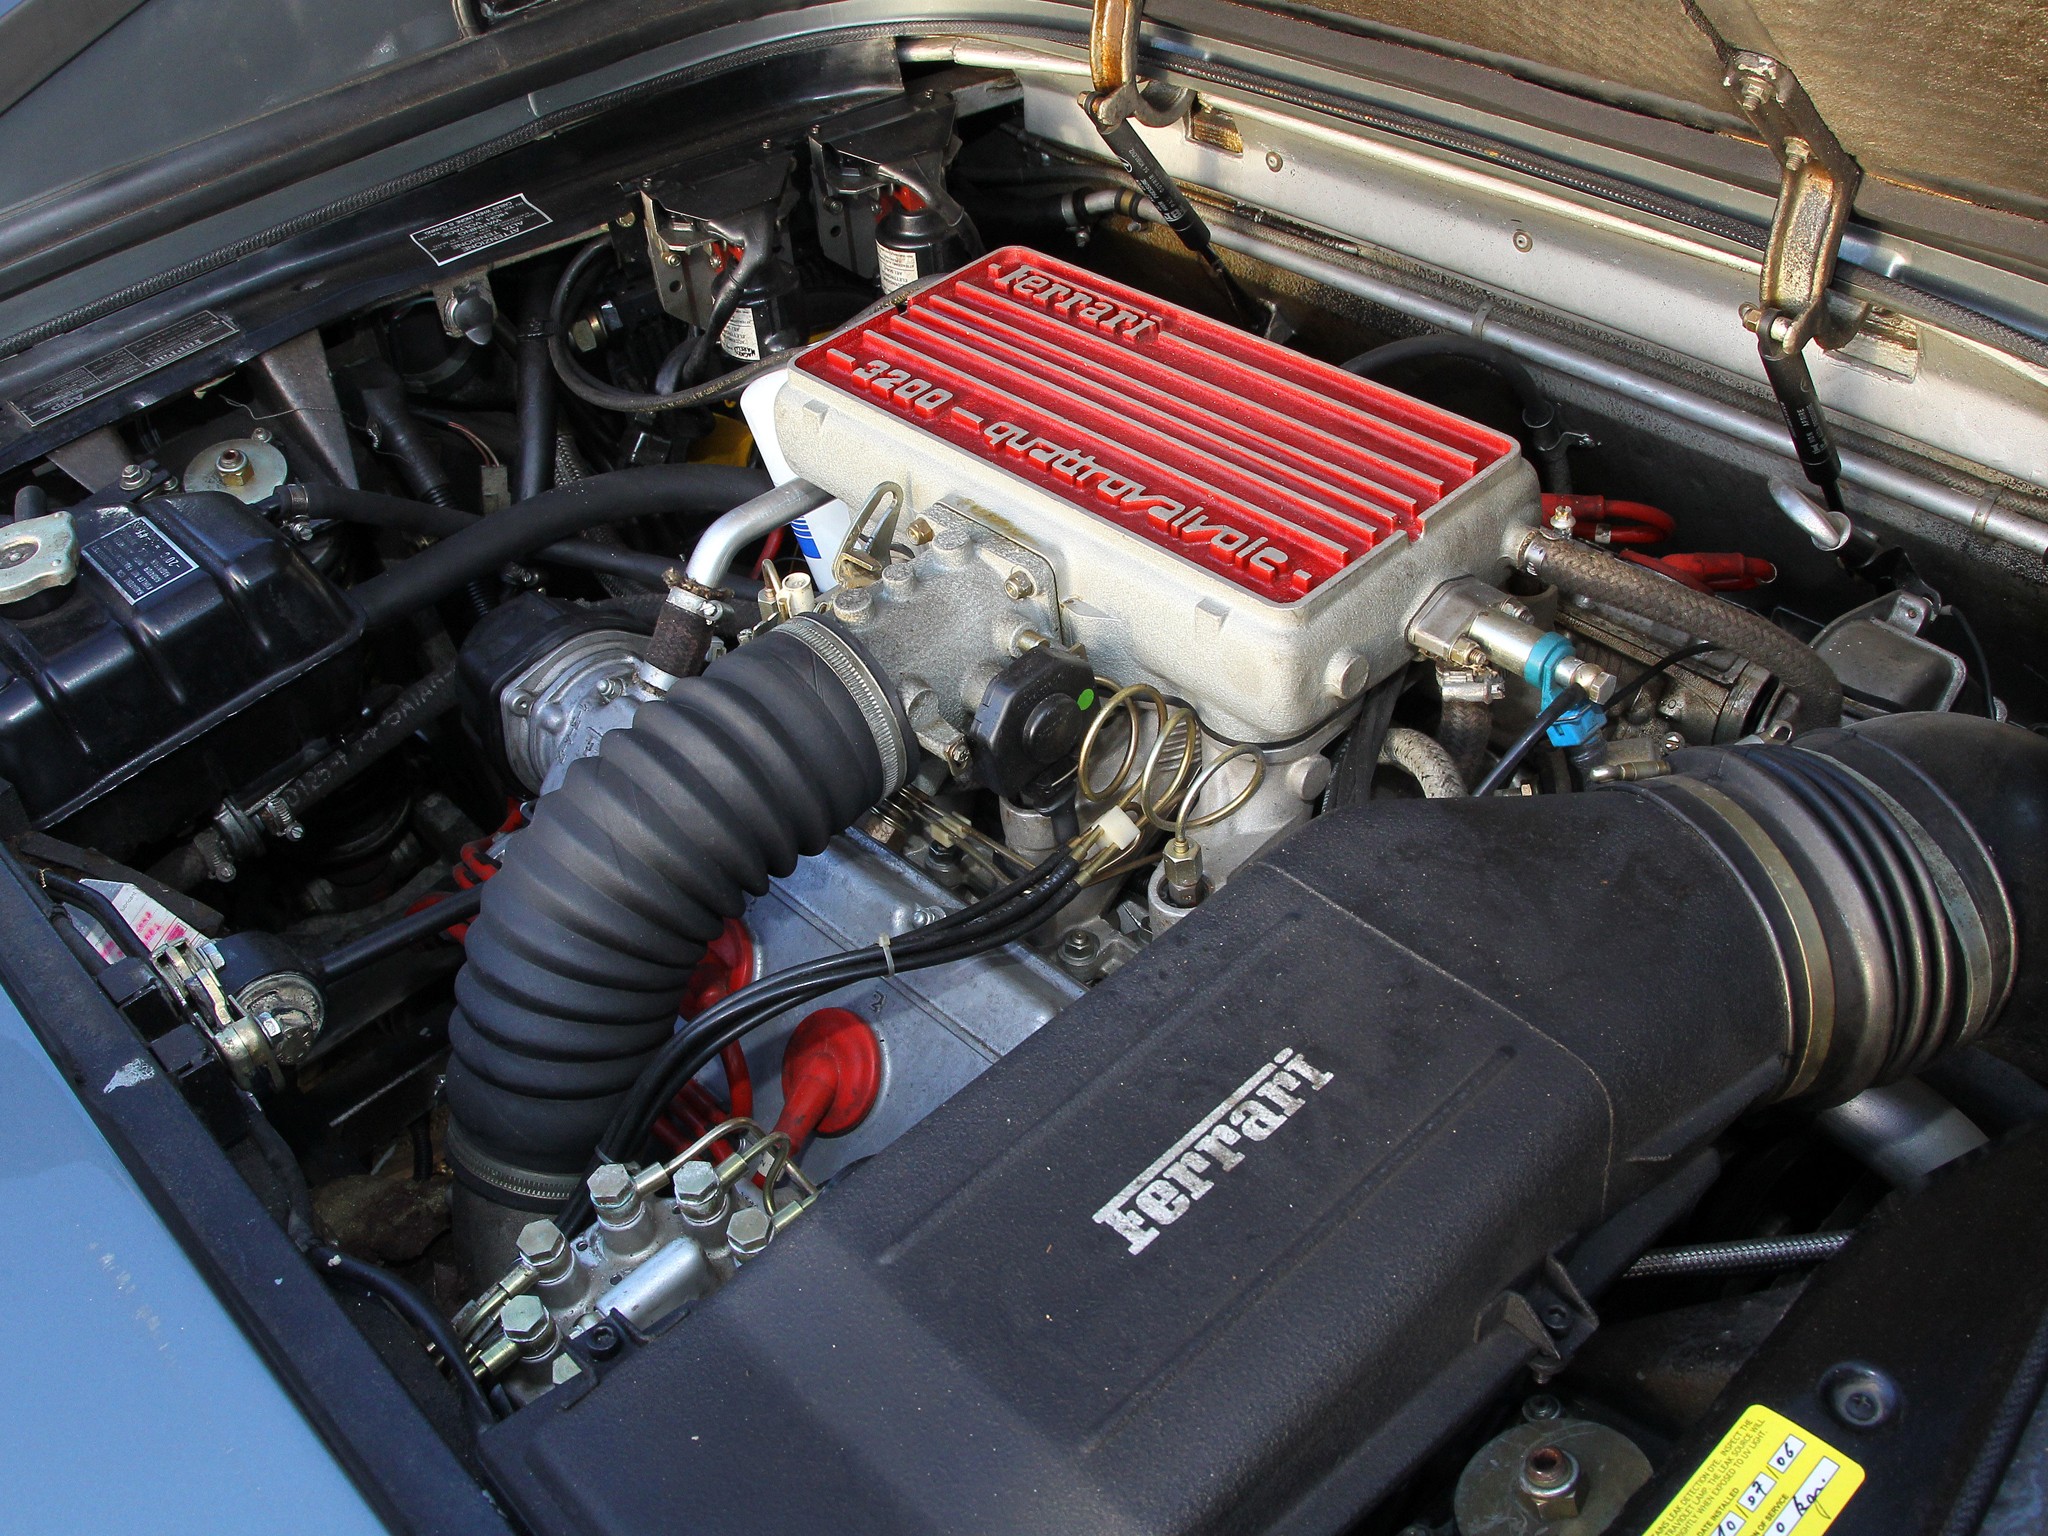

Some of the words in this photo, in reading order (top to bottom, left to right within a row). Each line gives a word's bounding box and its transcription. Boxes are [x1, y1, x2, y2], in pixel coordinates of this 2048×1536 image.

[450, 229, 499, 249] TENSIONE
[460, 227, 521, 252] ATTENZIONE
[501, 220, 524, 231] ALTA
[994, 264, 1163, 340] Ferrari
[853, 358, 954, 416] 3200
[983, 420, 1289, 578] quattrovalvole
[1092, 1047, 1334, 1255] Ferrari
[1666, 1504, 1683, 1522] LEAK
[1680, 1471, 1710, 1506] DETECTION
[1706, 1456, 1722, 1473] DYE.
[1719, 1430, 1743, 1456] INSPECT
[1739, 1417, 1753, 1432] THE
[1695, 1493, 1715, 1515] WHEN
[1710, 1466, 1737, 1496] EXPOSED
[1732, 1457, 1745, 1469] TO
[1740, 1447, 1752, 1460] UV
[1748, 1427, 1768, 1449] LIGHT.
[1707, 1471, 1721, 1486] THE
[1717, 1455, 1734, 1474] LEAK
[1730, 1432, 1753, 1457] SOURCE
[1749, 1417, 1765, 1434] WILL
[1777, 1442, 1793, 1466] 06
[1709, 1486, 1740, 1522] INSTALLED
[1757, 1520, 1768, 1531] OF
[1764, 1492, 1790, 1521] SERVICE
